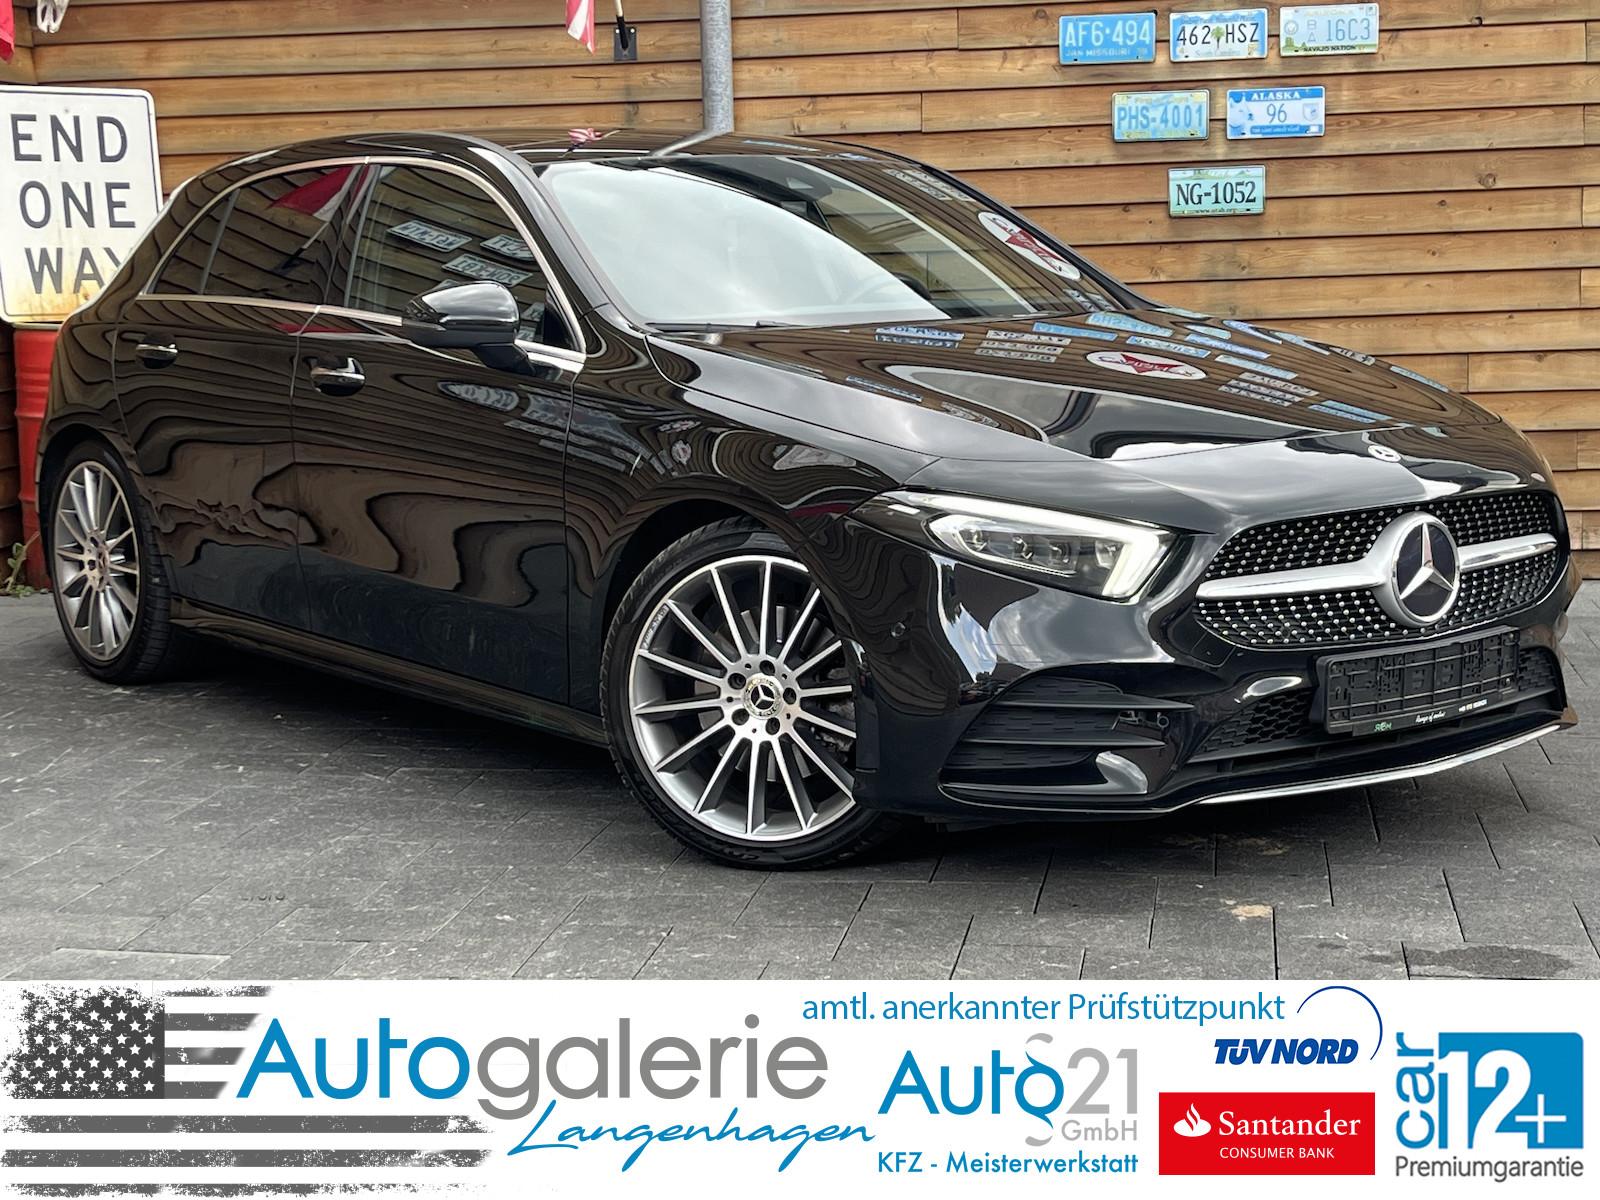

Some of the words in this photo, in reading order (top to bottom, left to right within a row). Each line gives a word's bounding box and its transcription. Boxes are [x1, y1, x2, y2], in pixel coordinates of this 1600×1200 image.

[1176, 25, 1211, 46] 462
[1225, 22, 1260, 43] HSZ
[1326, 18, 1371, 42] 16C3
[1251, 91, 1301, 101] ALASKA
[1117, 104, 1203, 130] PHS-4001
[1266, 103, 1288, 124] 96
[10, 113, 128, 163] END
[19, 180, 136, 229] ONE
[1176, 180, 1257, 206] NG-1052
